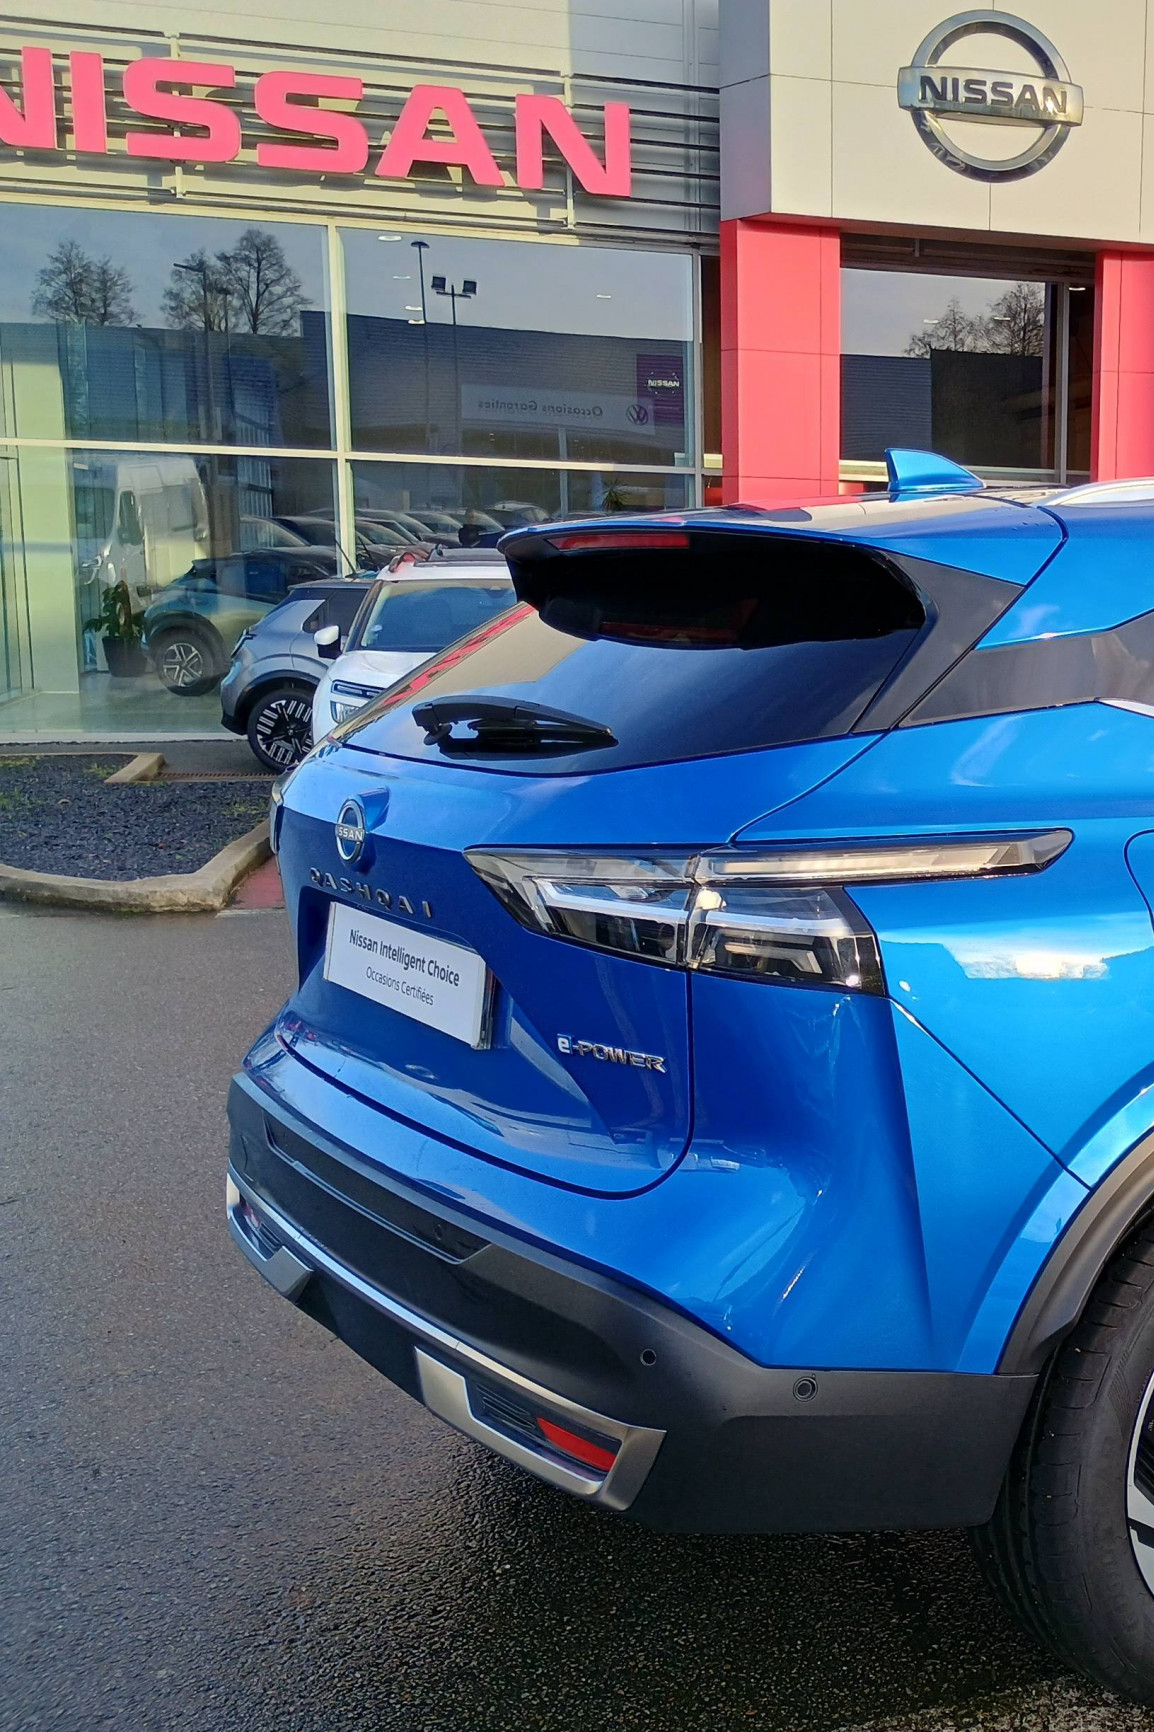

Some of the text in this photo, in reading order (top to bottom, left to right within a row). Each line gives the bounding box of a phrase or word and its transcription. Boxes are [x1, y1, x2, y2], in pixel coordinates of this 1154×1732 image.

[919, 75, 1068, 115] NISSAN
[647, 379, 680, 388] NISSAN
[309, 866, 433, 919] QASHQAI
[349, 928, 460, 988] Nissan Intelligent Choice
[365, 965, 434, 1006] Occasions Certifiées
